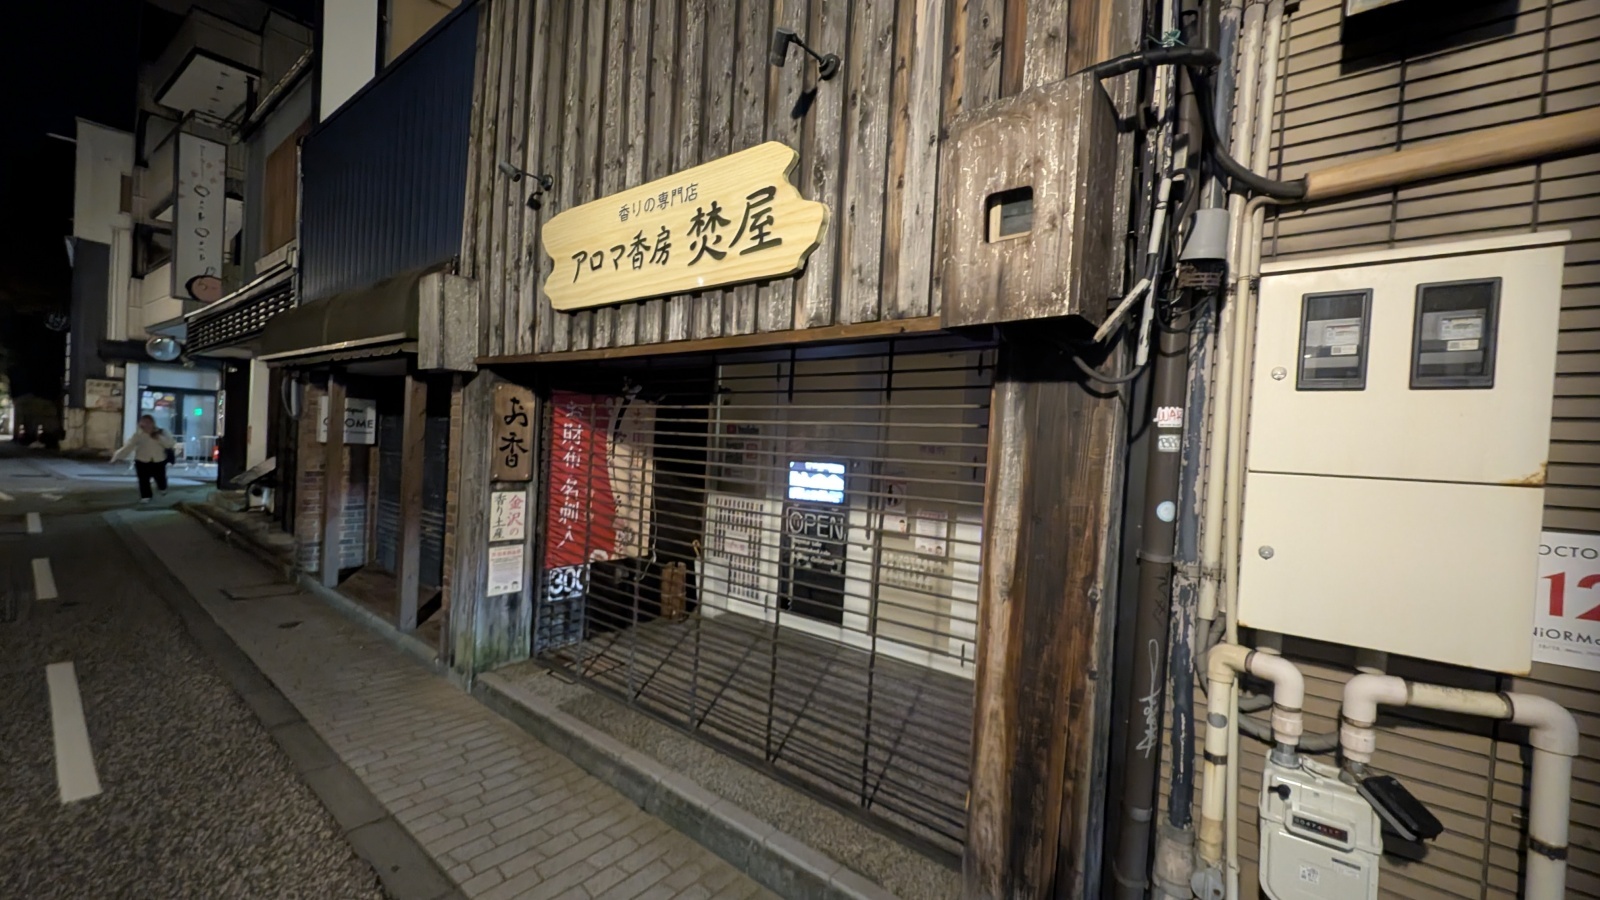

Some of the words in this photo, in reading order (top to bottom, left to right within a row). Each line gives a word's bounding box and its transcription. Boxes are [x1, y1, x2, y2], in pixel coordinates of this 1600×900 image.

[619, 183, 700, 222] 香りの専門店
[571, 226, 671, 284] アロマ香房
[686, 185, 783, 267] 焚屋
[499, 396, 529, 469] お香
[493, 493, 507, 540] 香り土産
[506, 494, 524, 537] 金沢の
[789, 511, 844, 541] OPEN
